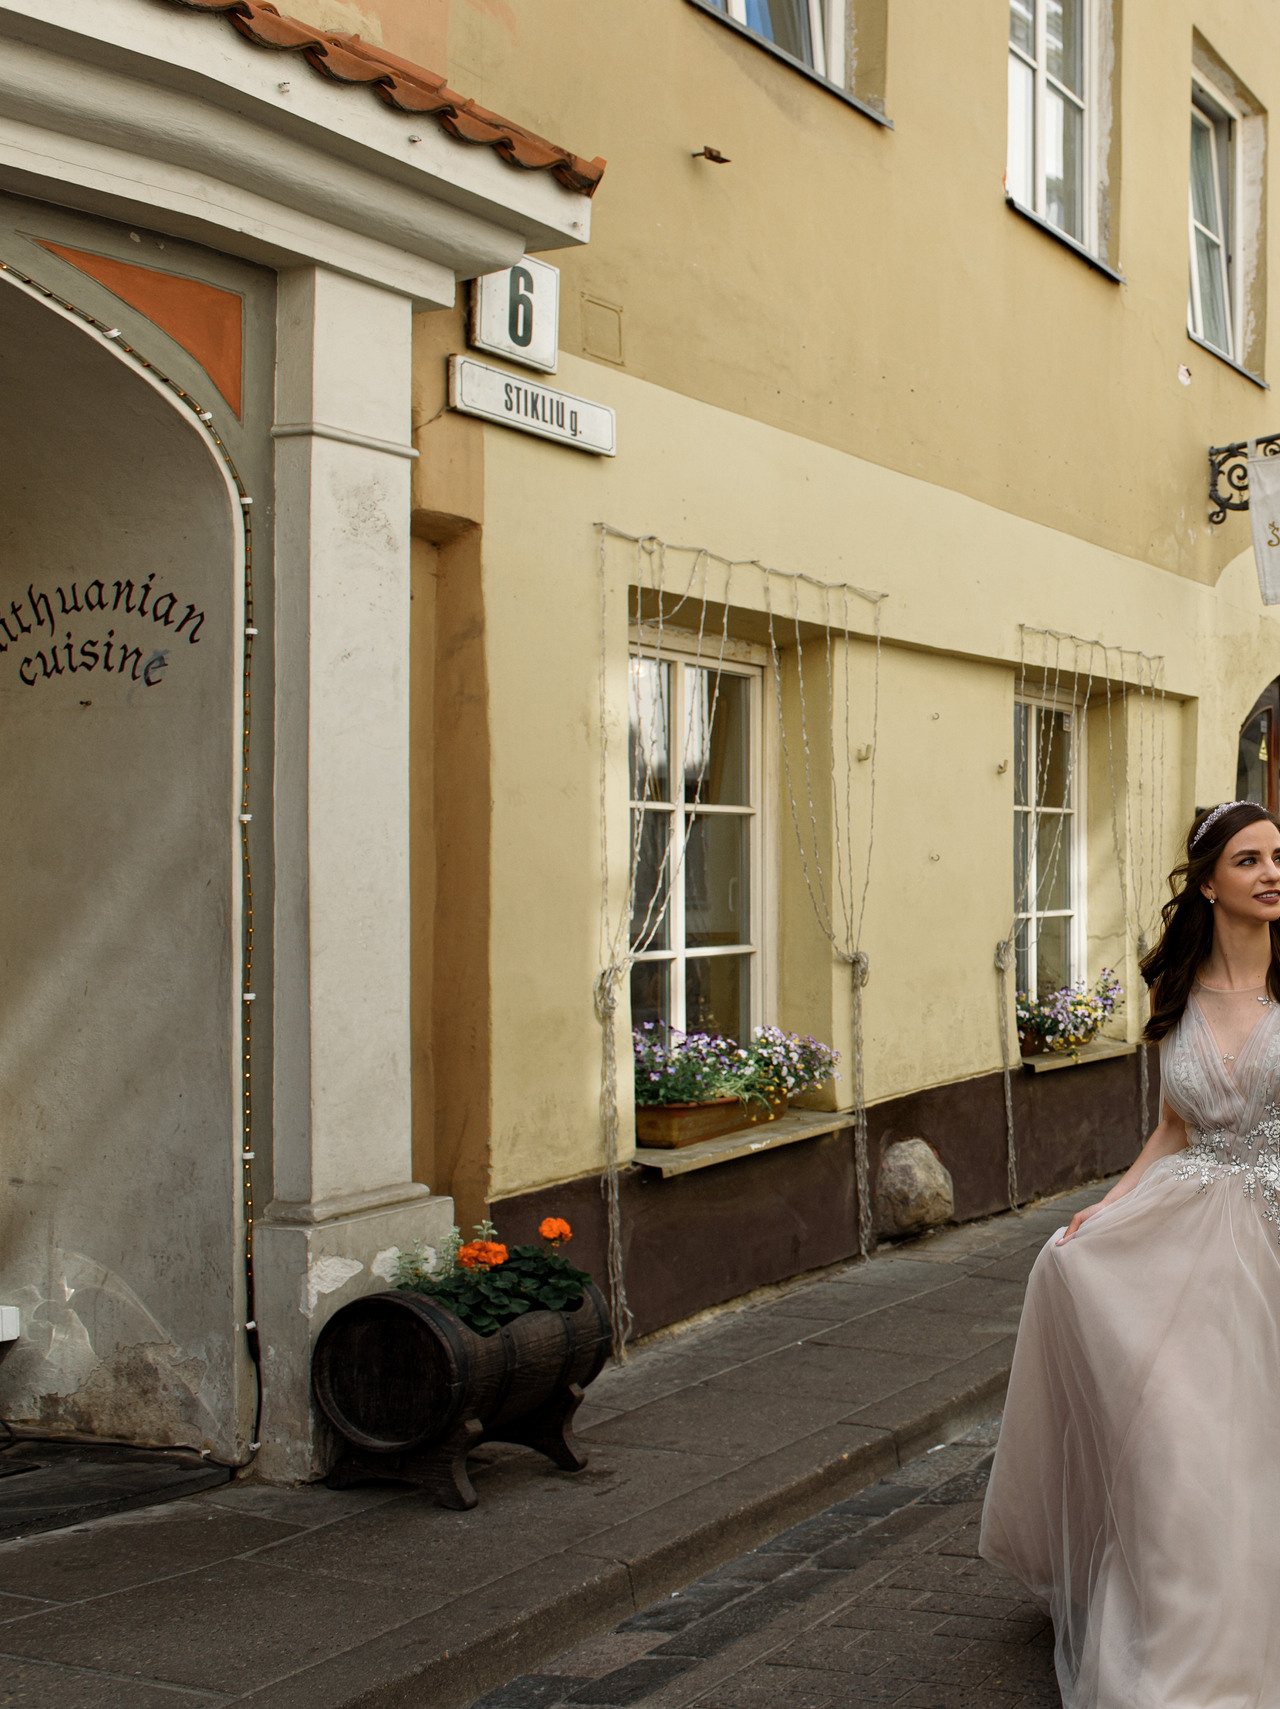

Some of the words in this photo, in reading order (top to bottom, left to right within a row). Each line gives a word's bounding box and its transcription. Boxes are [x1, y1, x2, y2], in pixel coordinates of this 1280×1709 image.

[508, 265, 534, 347] 6
[504, 382, 566, 430] STIKLIŲ
[569, 410, 583, 437] g.
[0, 573, 205, 652] ithuanian
[19, 629, 168, 687] cuisine
